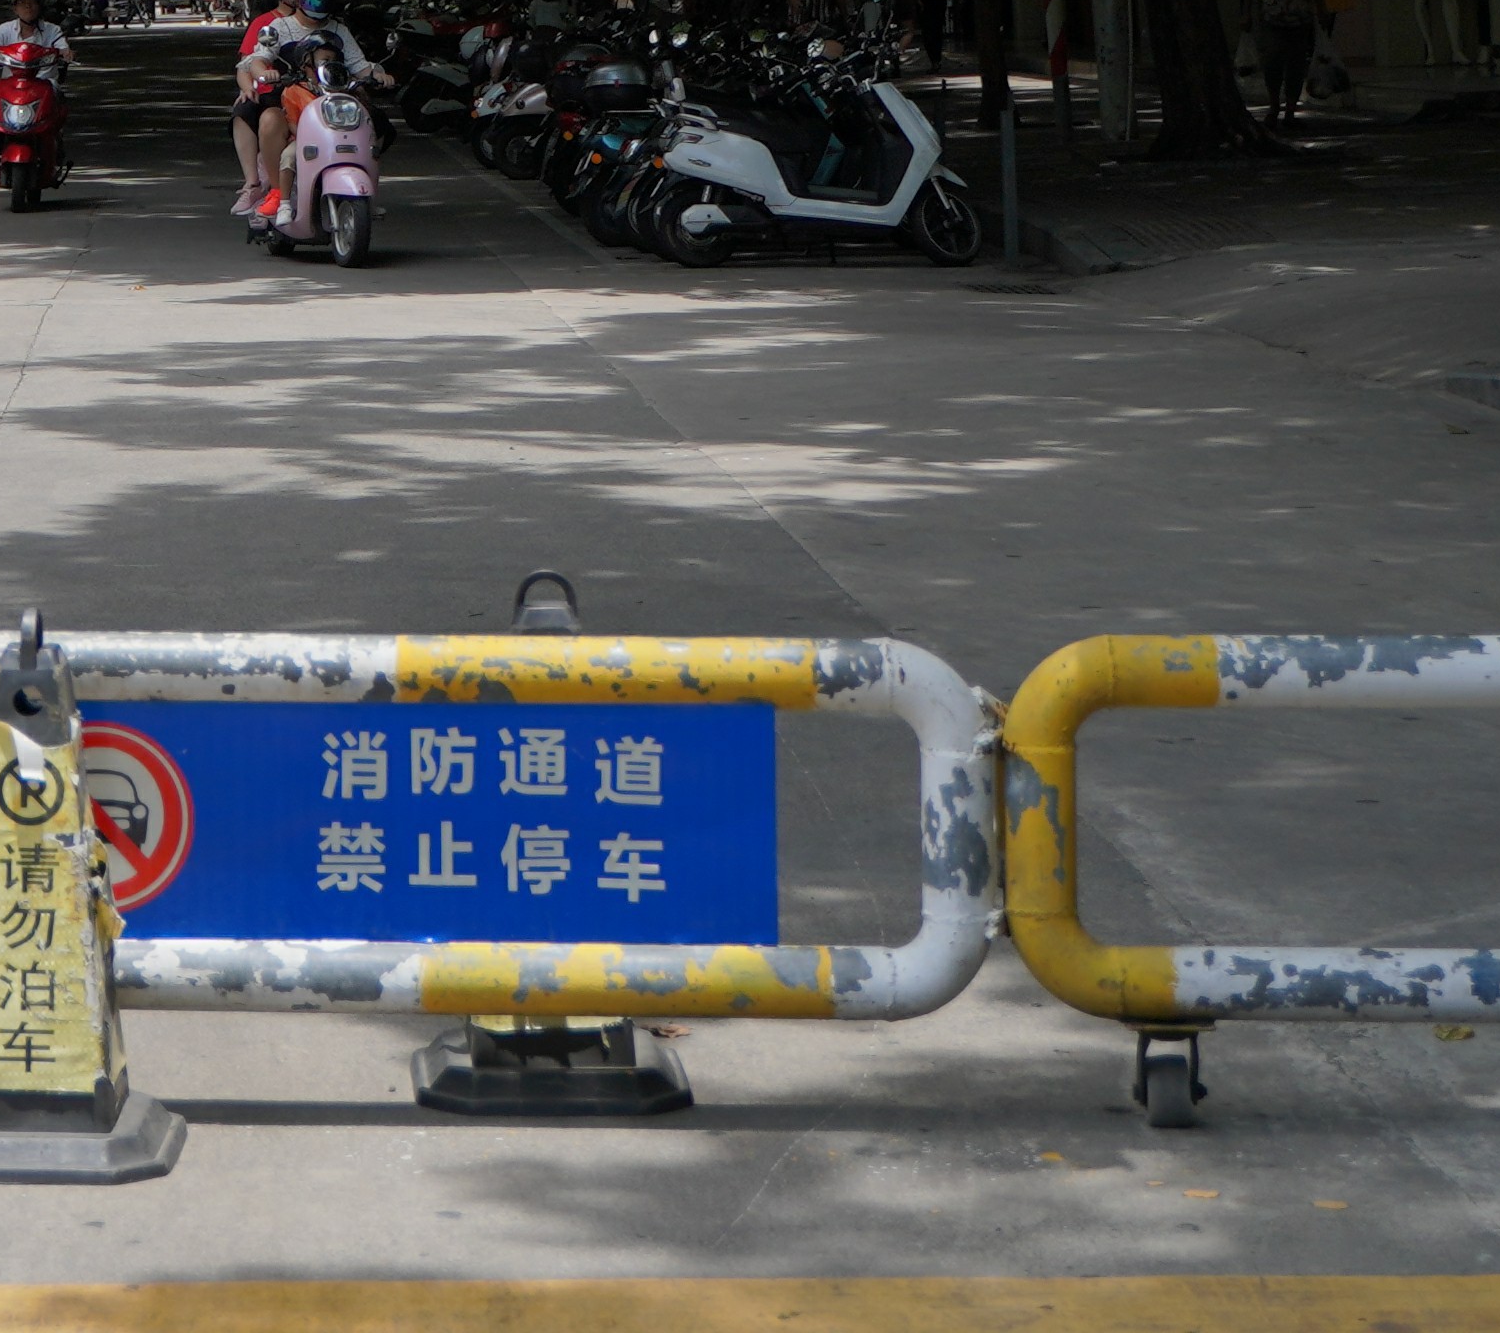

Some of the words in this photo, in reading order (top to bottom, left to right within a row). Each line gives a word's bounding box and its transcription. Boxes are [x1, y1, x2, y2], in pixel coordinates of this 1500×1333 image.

[321, 726, 664, 806] 消防通道
[315, 820, 667, 903] 禁止停车
